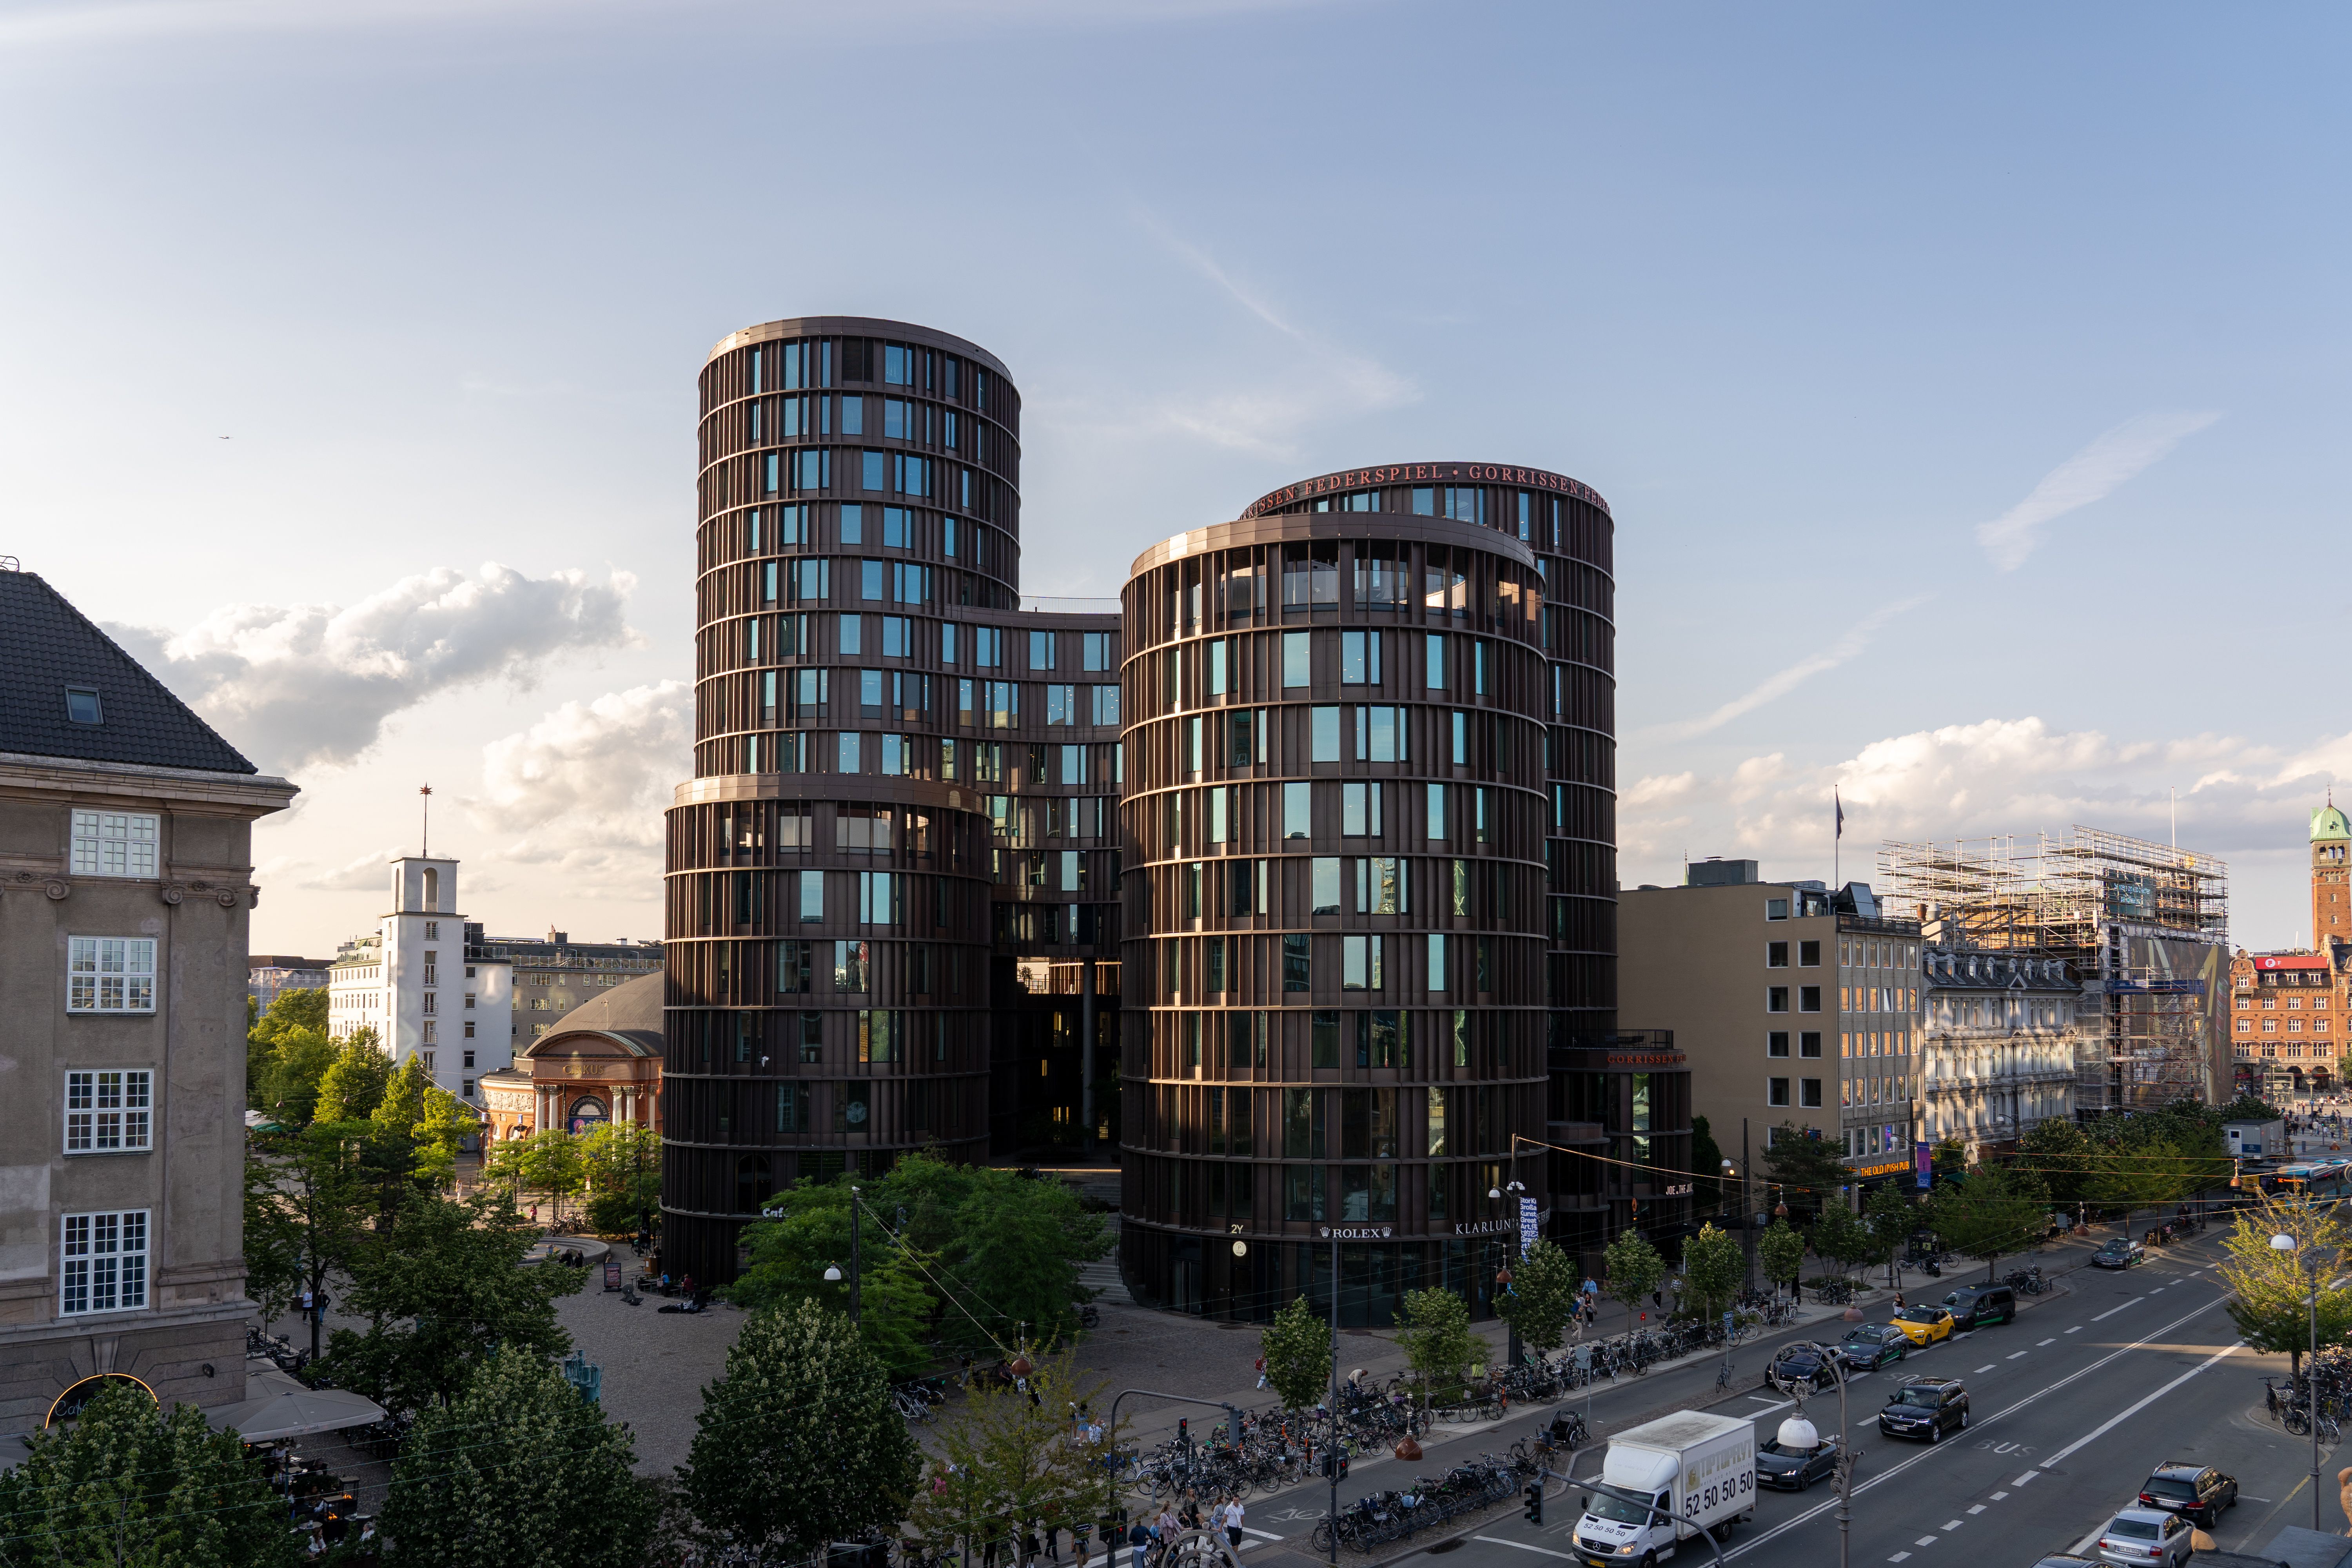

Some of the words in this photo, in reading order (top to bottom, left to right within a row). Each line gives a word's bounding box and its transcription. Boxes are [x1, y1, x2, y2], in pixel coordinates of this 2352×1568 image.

[1305, 465, 1442, 495] FEDERSPIEL
[1469, 465, 1578, 495] GORRISSEN
[1607, 1055, 1673, 1063] GORRISSEN
[563, 1064, 604, 1075] CIRKUS
[571, 1097, 608, 1115] CIRKUSBYGNINGENS
[1861, 1167, 1872, 1177] THE
[1873, 1165, 1884, 1175] OLD
[1899, 1161, 1909, 1171] PUB
[1666, 1186, 1675, 1195] JOE
[1231, 1224, 1244, 1234] 2Y
[1332, 1229, 1380, 1238] ROLEX
[1972, 1439, 2038, 1457] BUS
[1700, 1438, 1753, 1478] TIPTOPFLYT
[1686, 1494, 1700, 1518] 52
[1704, 1485, 1718, 1510] 50
[1722, 1477, 1735, 1501] 50
[1740, 1470, 1753, 1494] 50
